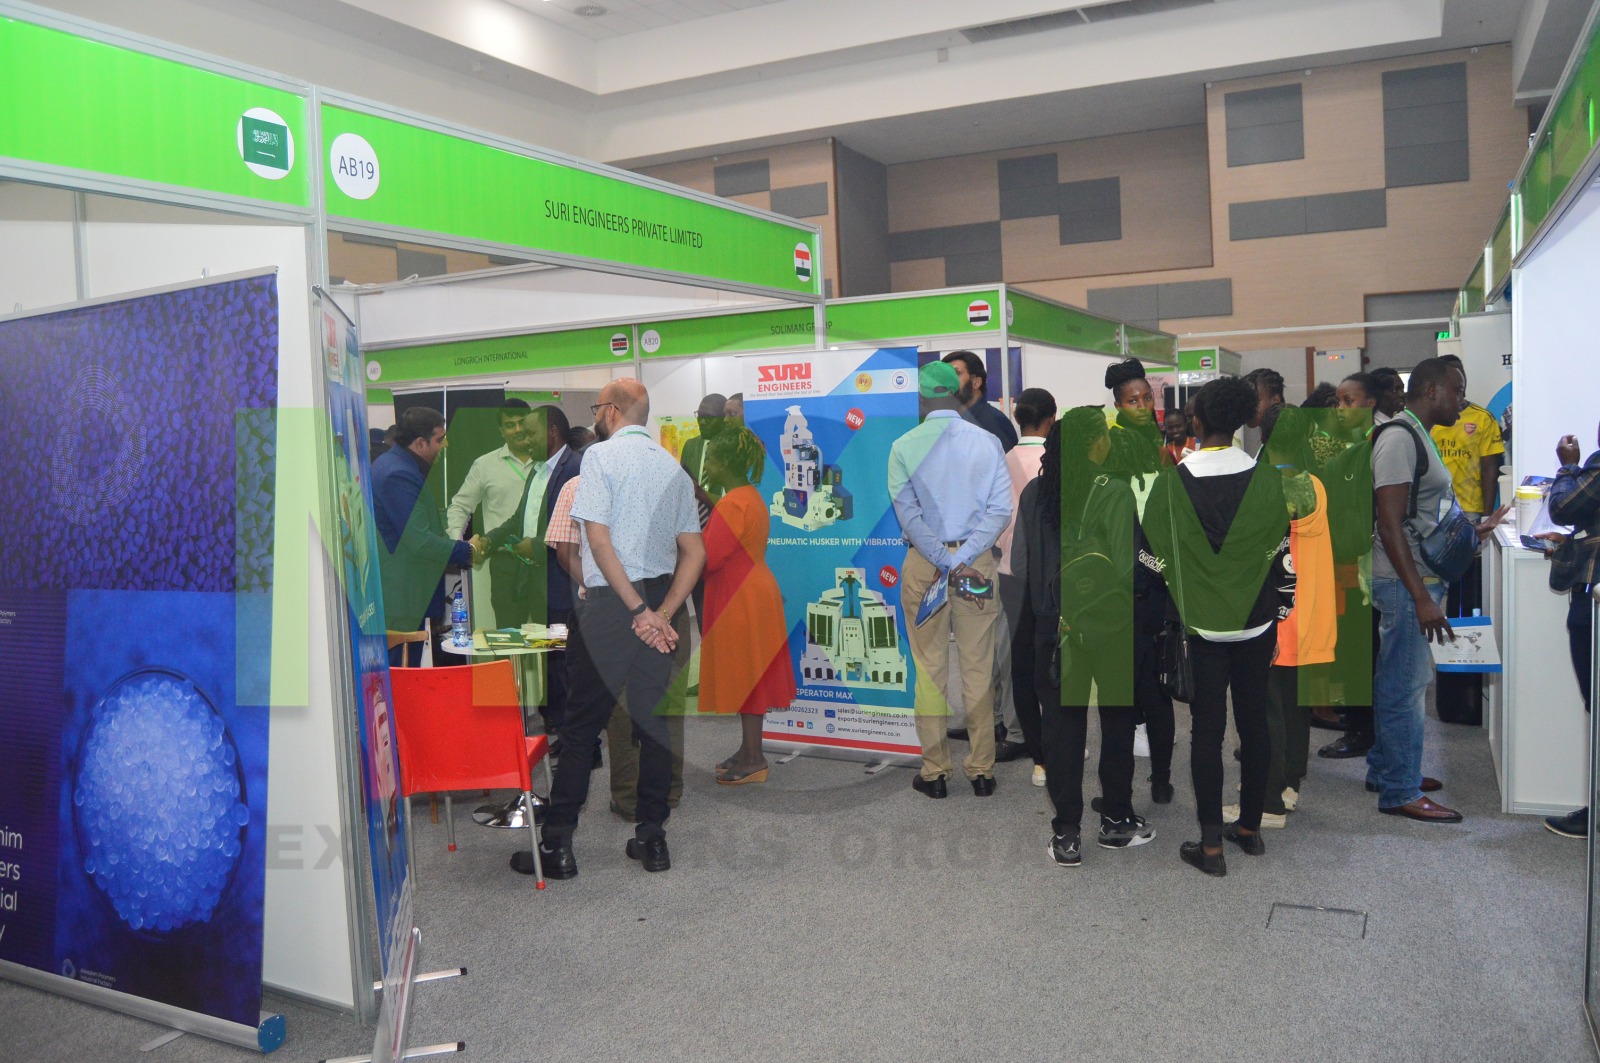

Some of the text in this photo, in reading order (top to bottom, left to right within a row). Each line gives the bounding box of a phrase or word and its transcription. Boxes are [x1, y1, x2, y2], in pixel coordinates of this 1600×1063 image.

[338, 155, 375, 181] AB19
[544, 198, 703, 249] SURI ENGINEERS PRIVATE LIMITED
[770, 323, 804, 335] SOLIMAN
[642, 336, 660, 347] AB20
[454, 351, 529, 366] LONGRICH INTERNATIONAL
[757, 362, 812, 382] SURI
[758, 380, 812, 393] ENGINEERS
[847, 411, 863, 427] NEW
[766, 537, 904, 546] PNEUMATIC HUSKER WITH VIBRATOR
[880, 569, 897, 584] NEW
[835, 691, 853, 700] MAX
[837, 726, 901, 737] www.suriengineers.co.in
